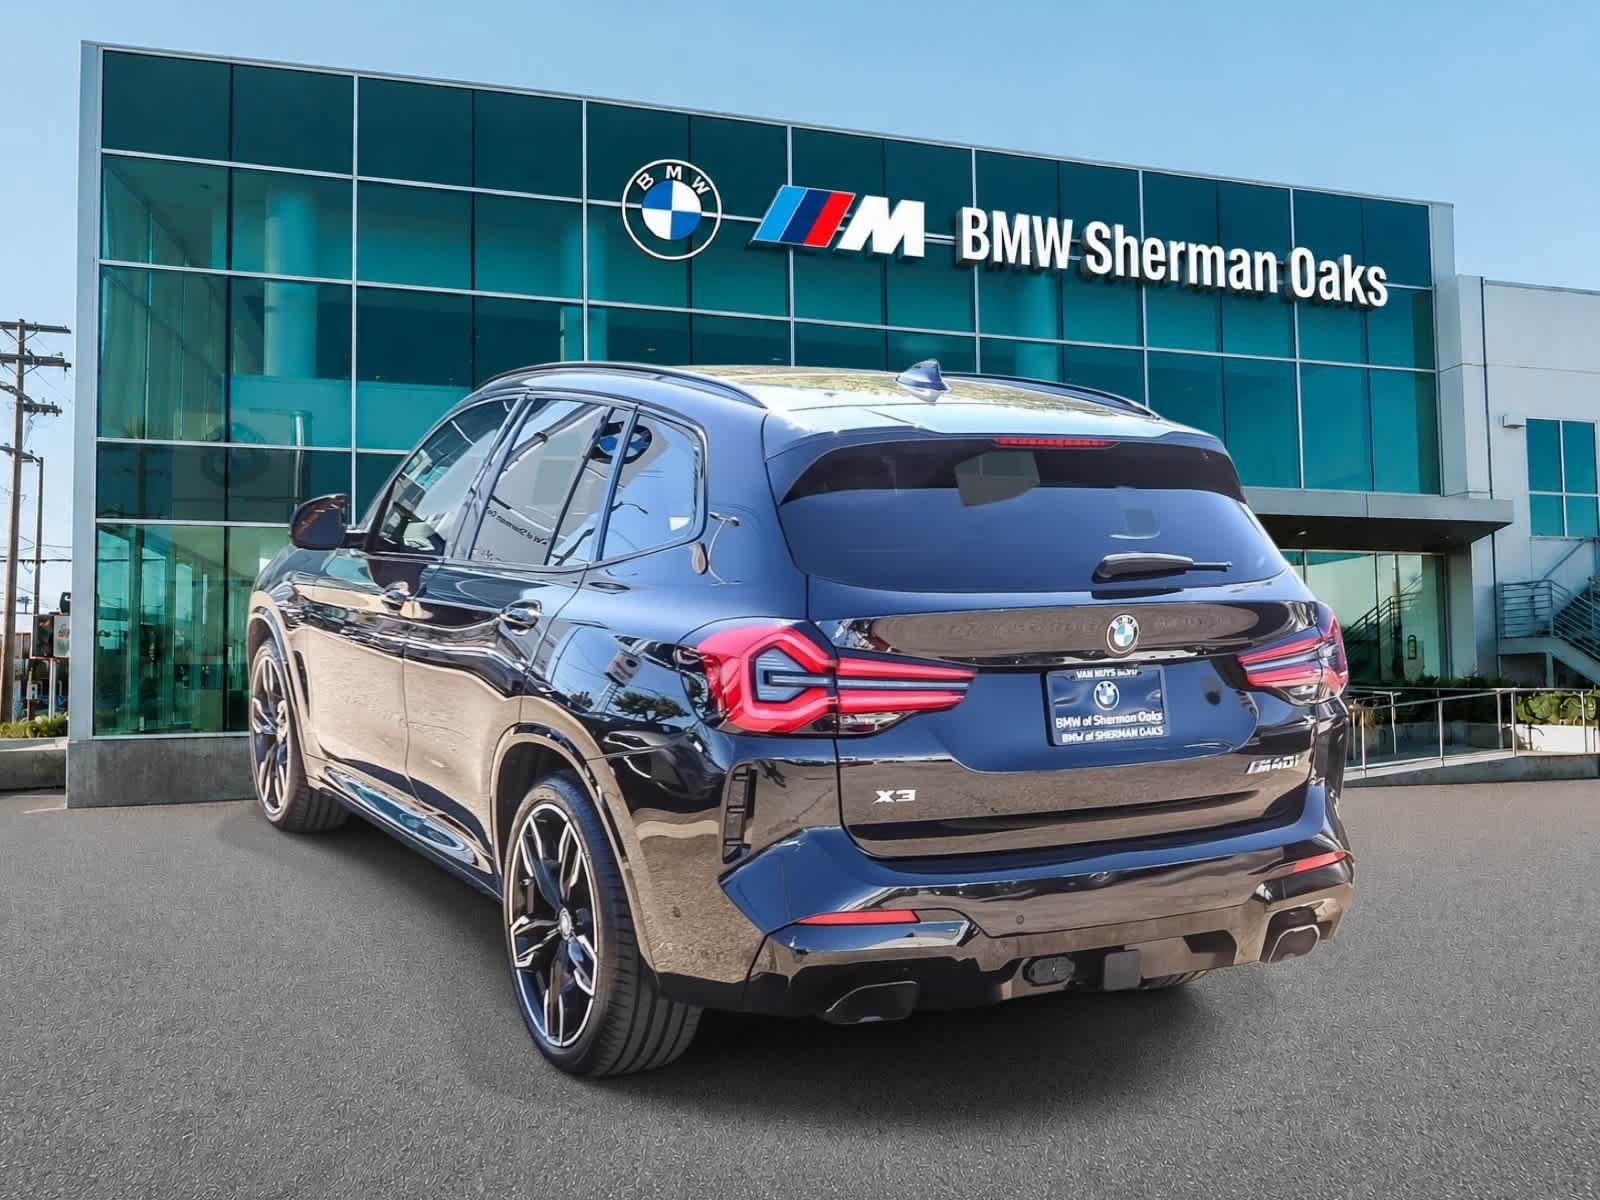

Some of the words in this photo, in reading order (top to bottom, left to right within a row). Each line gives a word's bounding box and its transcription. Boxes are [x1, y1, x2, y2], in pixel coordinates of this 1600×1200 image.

[636, 165, 712, 195] BMW
[836, 195, 925, 258] M
[959, 206, 1074, 269] BMW
[1084, 220, 1278, 294] Sherman
[1288, 247, 1388, 307] Oaks
[1076, 669, 1093, 679] VAN
[1055, 715, 1081, 728] BMW
[1082, 716, 1092, 727] of
[1093, 714, 1136, 726] Sherman
[1138, 711, 1163, 723] Oaks
[1062, 732, 1083, 743] BMW
[1094, 727, 1138, 739] SHERMAN
[1139, 726, 1163, 737] OAKS
[872, 790, 916, 804] X3
